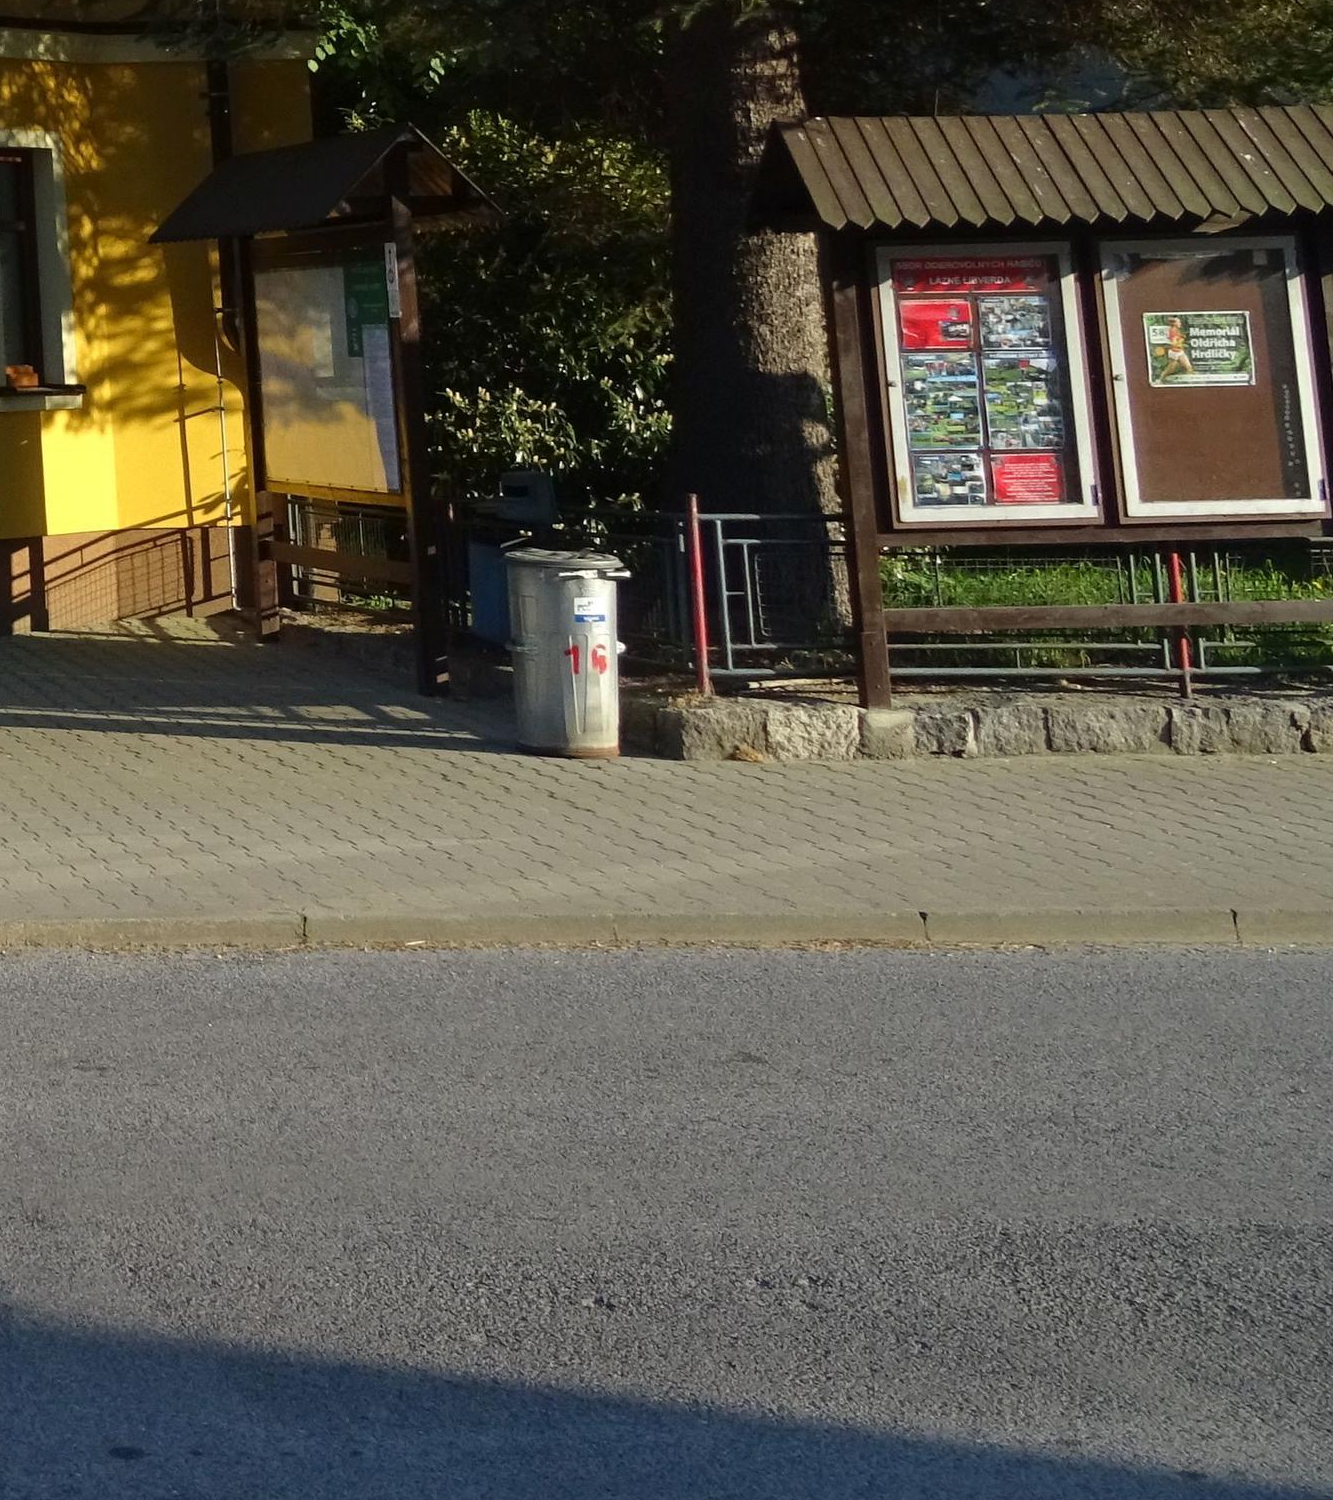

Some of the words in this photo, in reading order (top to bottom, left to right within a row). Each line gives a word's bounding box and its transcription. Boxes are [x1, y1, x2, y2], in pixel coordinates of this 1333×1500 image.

[963, 275, 1012, 285] LIBVERDA
[1189, 326, 1240, 337] Memoriál
[1190, 337, 1236, 348] Oldřicha
[1191, 348, 1237, 360] Hrdličky
